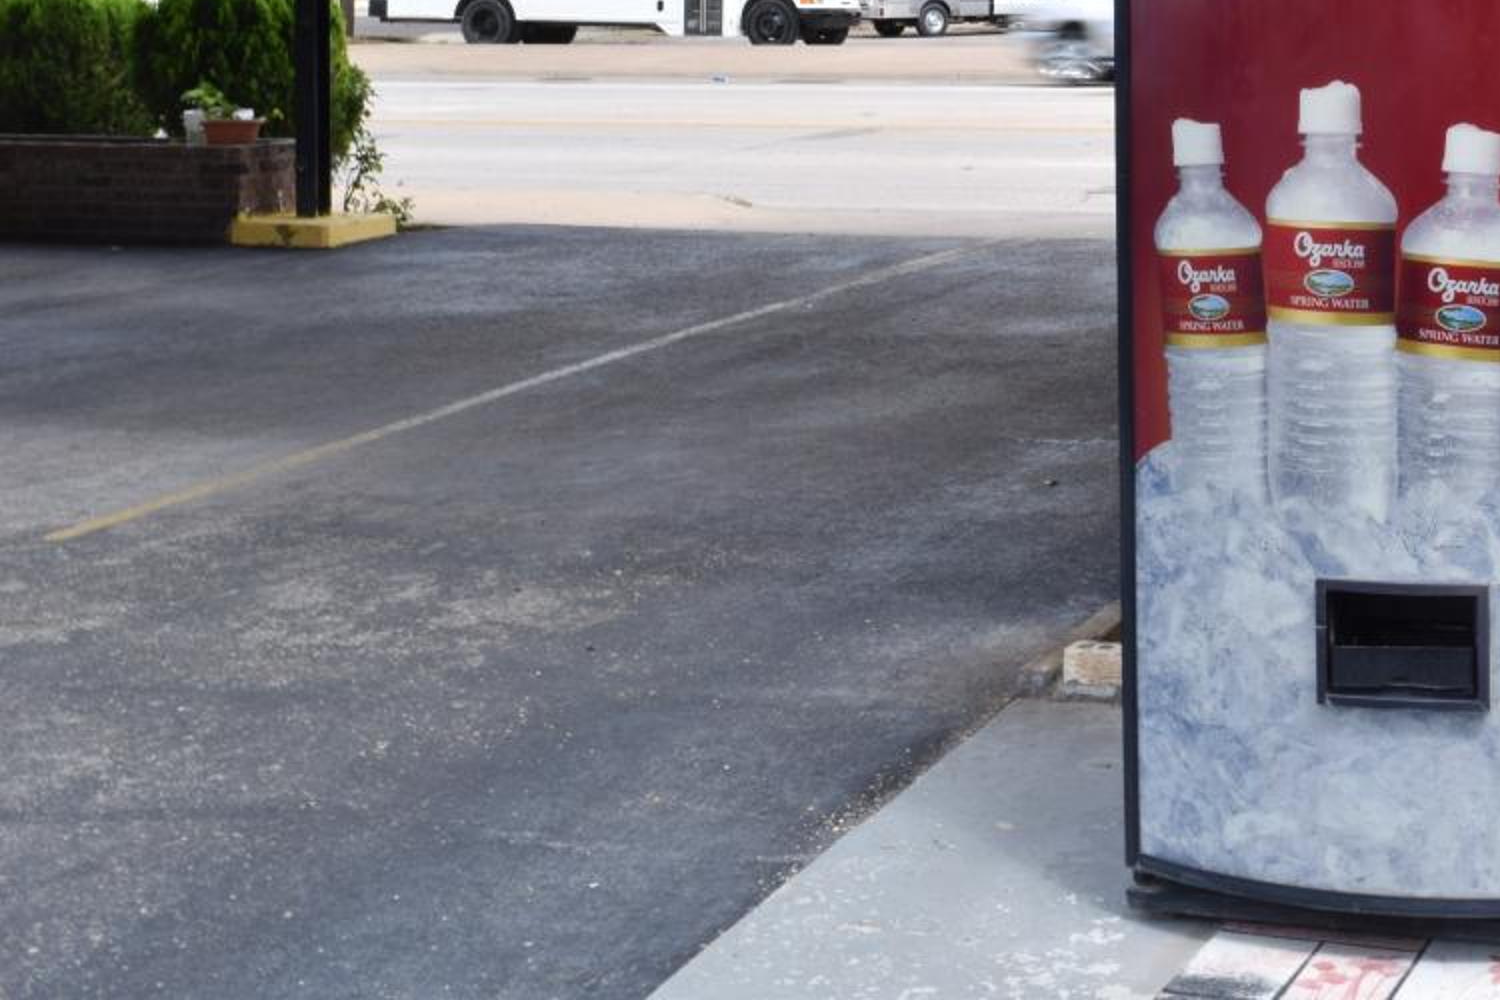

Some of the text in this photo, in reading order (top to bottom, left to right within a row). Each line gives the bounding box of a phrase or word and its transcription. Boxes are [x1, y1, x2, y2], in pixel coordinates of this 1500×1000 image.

[1294, 231, 1366, 267] Ozarka
[1177, 259, 1236, 293] Ozarka
[1427, 267, 1500, 302] Ozarka
